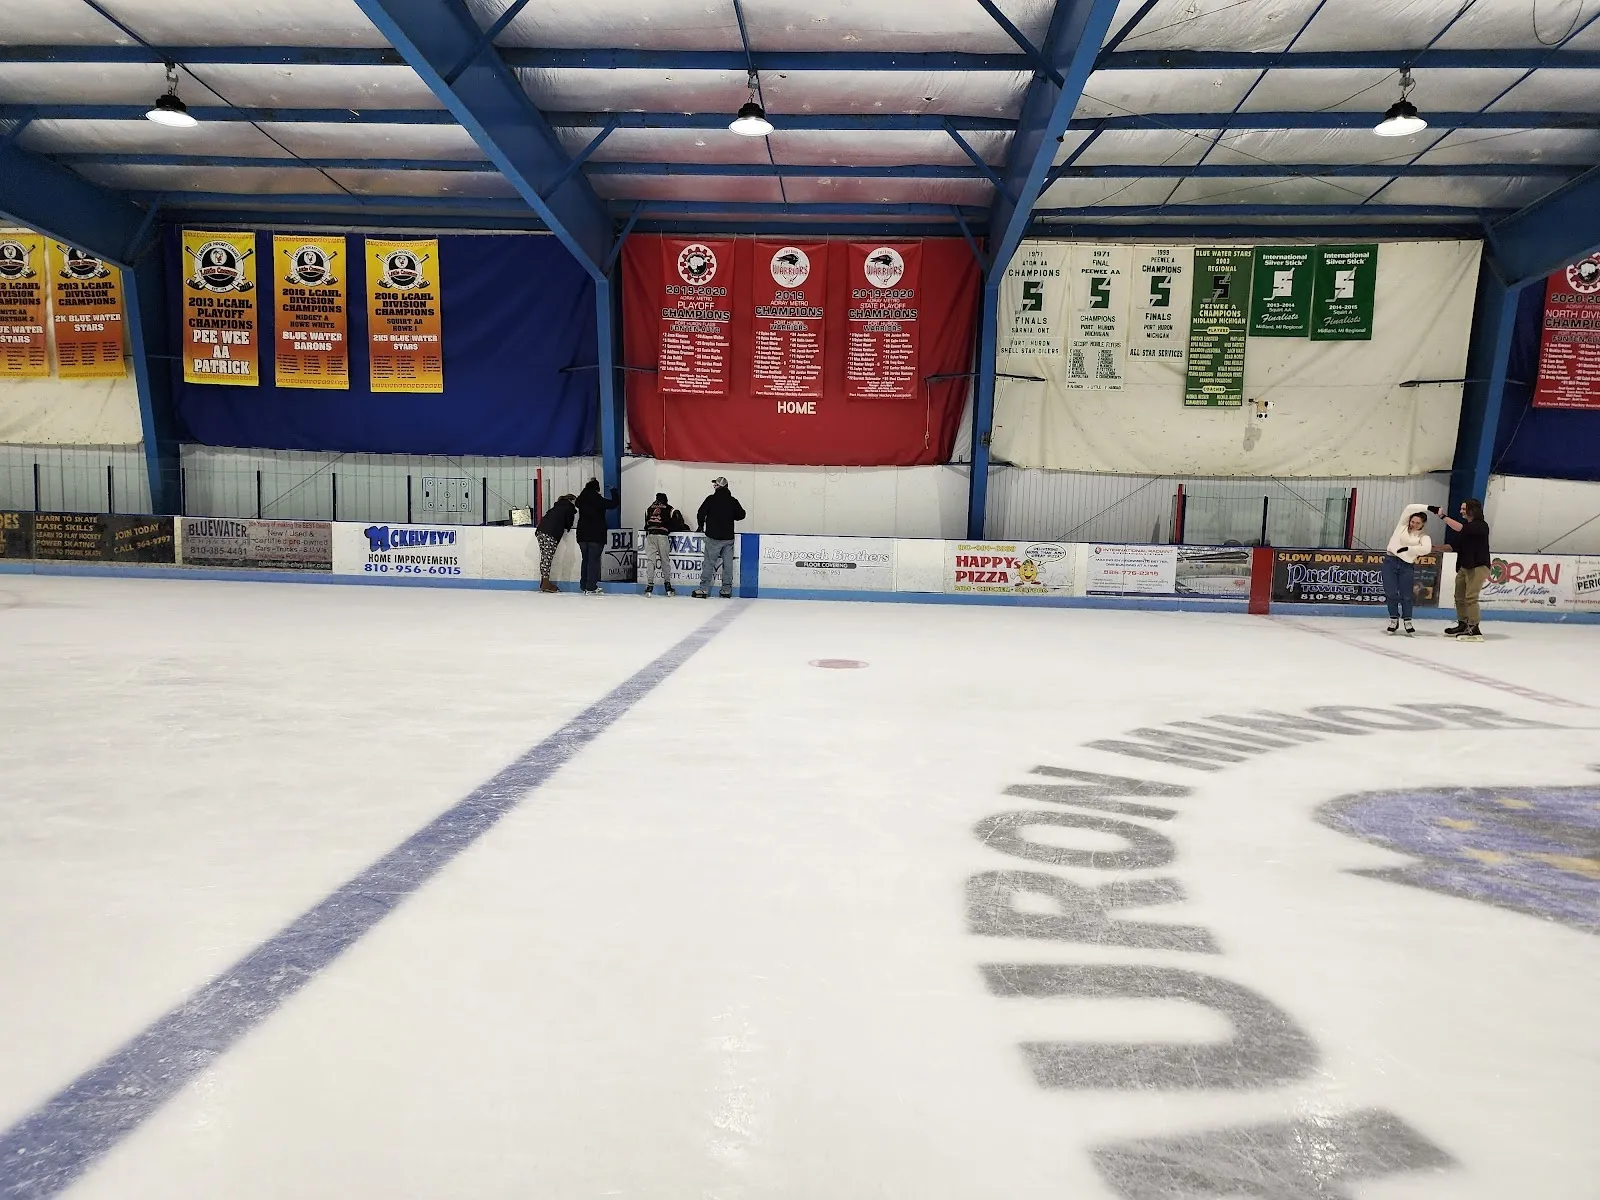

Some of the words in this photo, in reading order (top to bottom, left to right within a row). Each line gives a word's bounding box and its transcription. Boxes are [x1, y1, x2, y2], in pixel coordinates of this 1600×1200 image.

[1142, 265, 1182, 273] CHAMPIONS
[309, 289, 342, 297] LCAHL
[666, 285, 727, 296] 2019-2020
[775, 291, 804, 300] 2019
[852, 288, 914, 298] 2019-2020
[189, 298, 213, 307] 2013
[216, 298, 252, 308] LCAHL
[1552, 293, 1600, 304] 2020-20
[283, 304, 342, 313] CHAMPIONS
[678, 301, 715, 310] PLAYOFF
[755, 306, 823, 316] CHAMPIONS
[197, 308, 244, 319] PLAYOFF
[662, 308, 730, 320] CHAMPIONS
[848, 309, 918, 318] CHAMPIONS
[1145, 313, 1172, 321] FINALS
[1262, 313, 1299, 324] Finalists
[1546, 309, 1578, 318] NORTH
[189, 318, 253, 329] CHAMPIONS
[1324, 316, 1361, 326] Finalists
[1545, 318, 1600, 328] CHAMPIO
[12, 326, 44, 334] WATER
[74, 323, 104, 332] STARS
[193, 330, 218, 344] PEE
[222, 330, 250, 345] WEE
[282, 331, 307, 340] BLUE
[310, 332, 342, 341] WATER
[212, 345, 230, 359] AA
[294, 342, 332, 351] BARONS
[194, 359, 250, 374] PATRICK
[778, 401, 816, 414] HOME
[115, 529, 132, 540] JOIN
[134, 523, 160, 535] TODAY
[188, 520, 247, 537] BLUEWATER
[289, 529, 306, 537] Used
[114, 544, 134, 554] CALL
[368, 554, 391, 563] HOME
[394, 555, 458, 565] IMPROVEMENTS
[832, 549, 890, 562] Brothers
[1278, 553, 1312, 562] SLOW
[1315, 554, 1351, 563] DOWN
[1354, 555, 1364, 563] &
[1413, 556, 1437, 565] VER
[364, 564, 461, 575] 810-956-6015
[672, 559, 701, 570] VIDE
[955, 571, 1009, 583] PIZZA
[1488, 562, 1560, 584] ORAN
[1301, 585, 1358, 594] TOWING,
[1484, 584, 1512, 596] Blue
[1514, 585, 1550, 596] Water
[1081, 704, 1578, 771] MINOR
